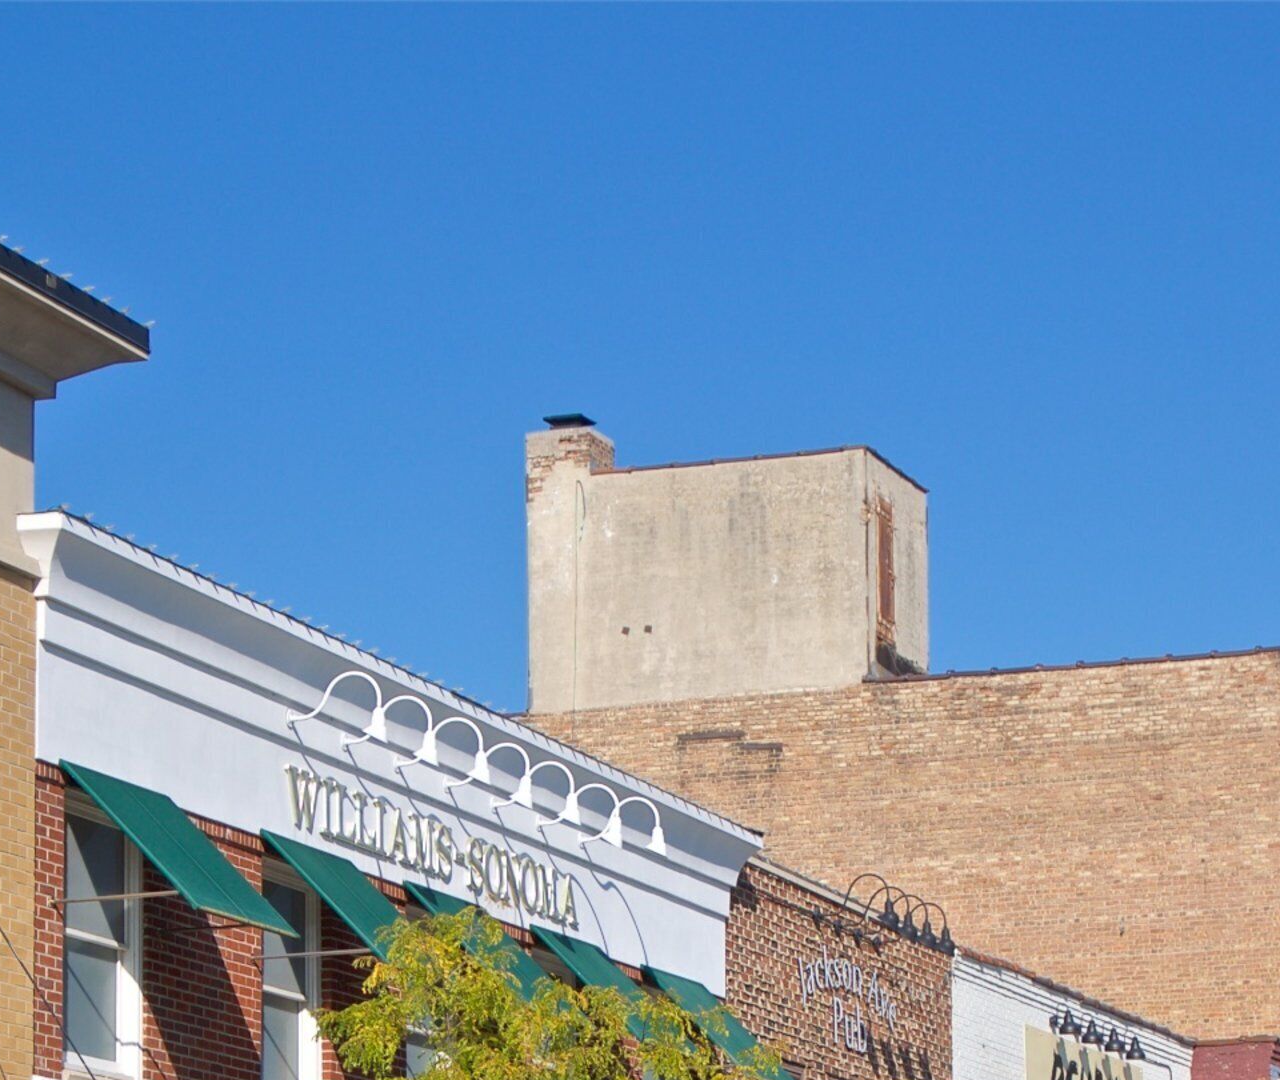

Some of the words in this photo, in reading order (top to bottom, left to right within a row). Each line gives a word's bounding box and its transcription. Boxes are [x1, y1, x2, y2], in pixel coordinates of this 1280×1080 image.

[283, 763, 579, 932] WILLIAMS-SONOMA
[798, 944, 863, 1009] Jackson
[867, 968, 897, 1034] Ave
[833, 996, 868, 1054] Pub
